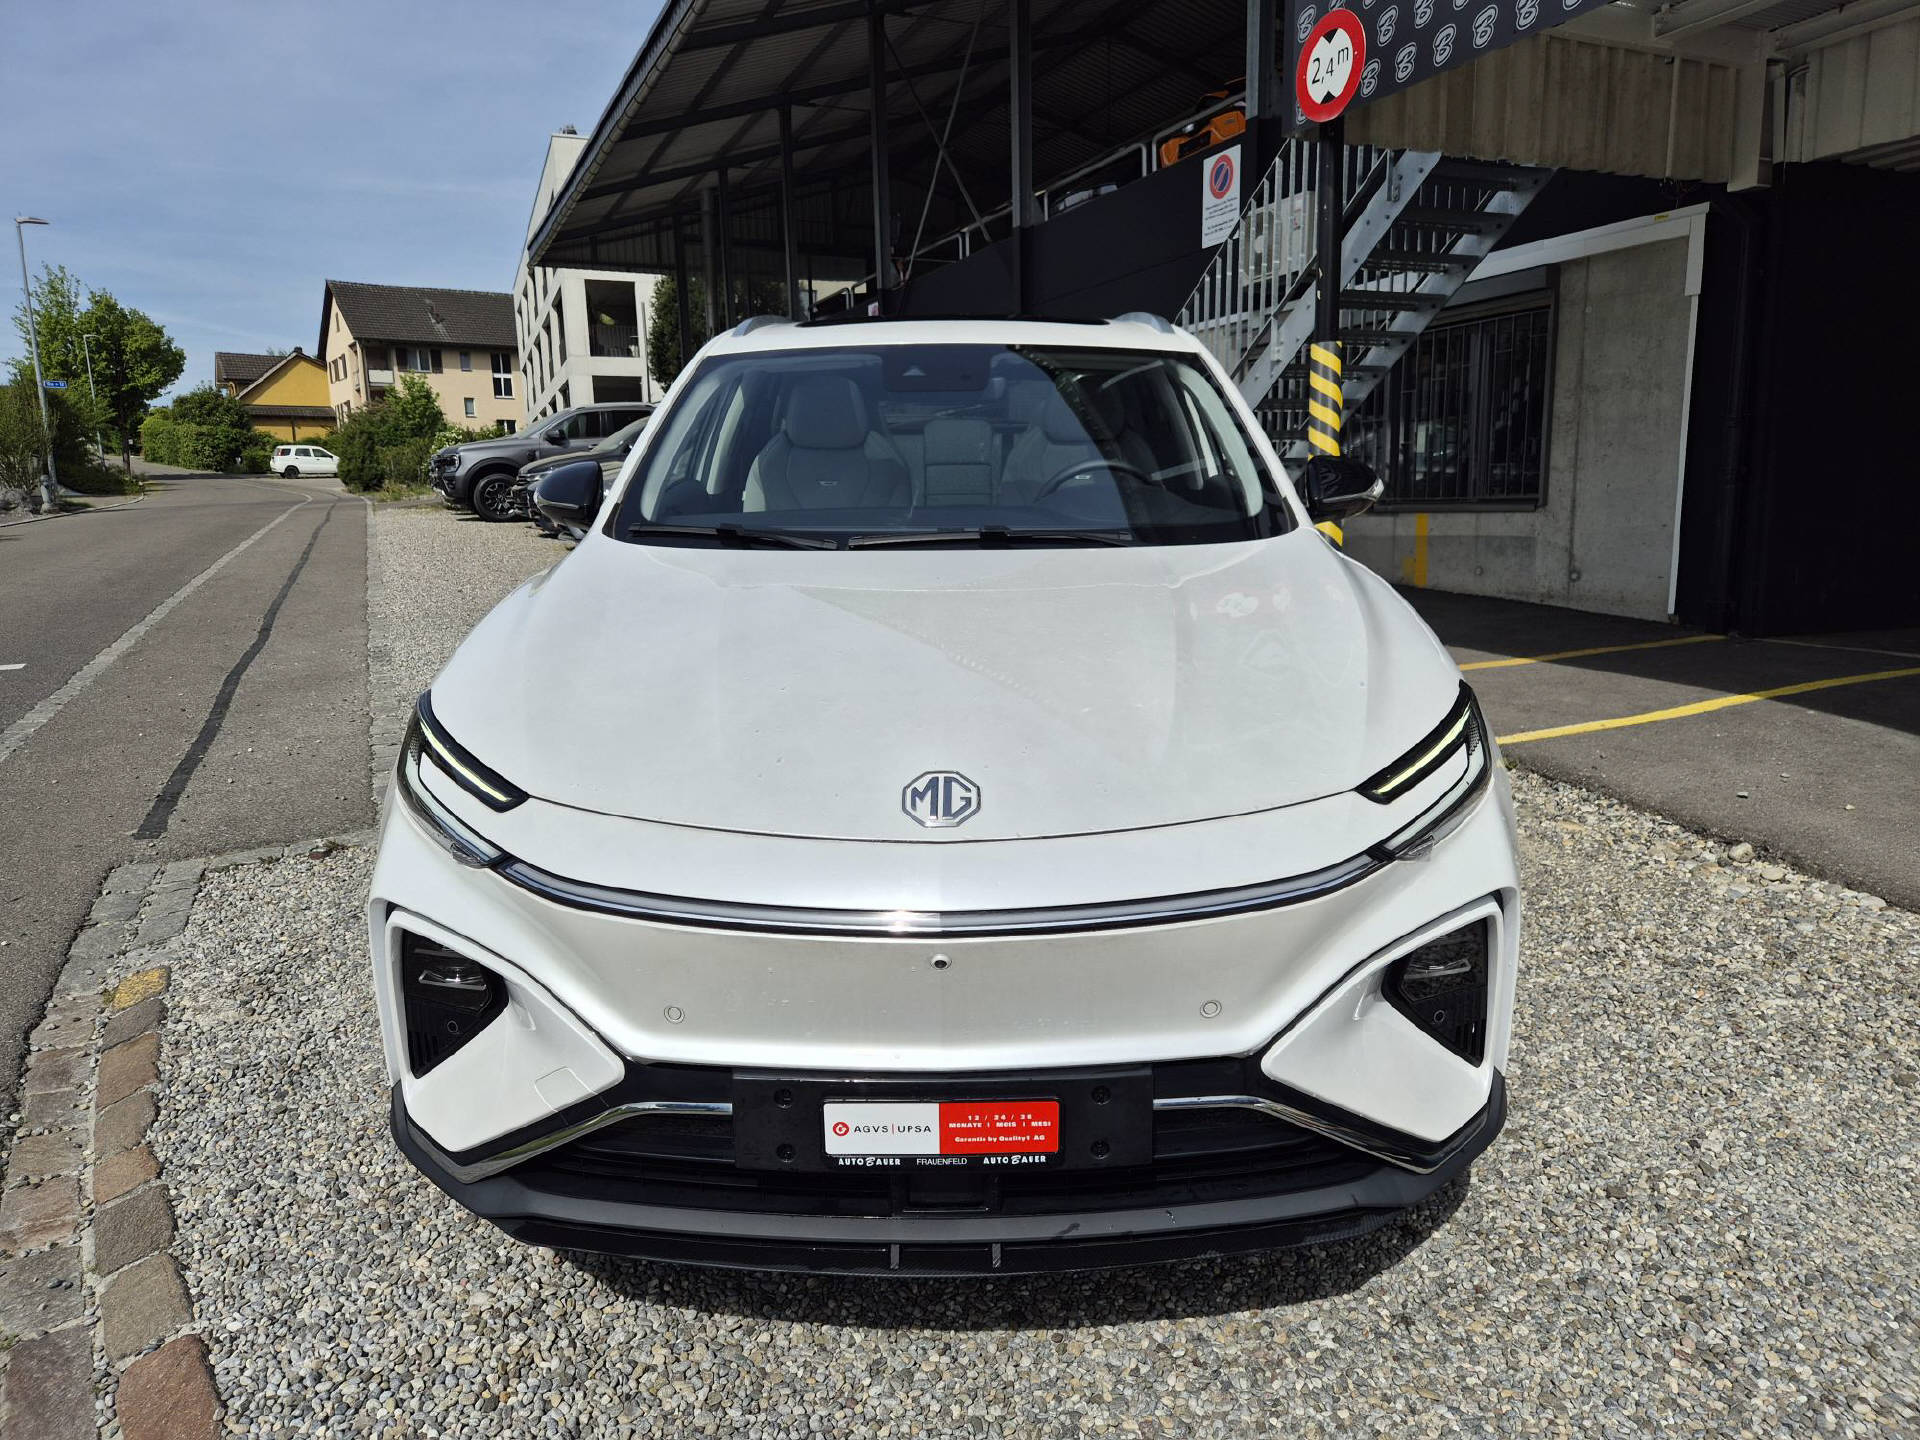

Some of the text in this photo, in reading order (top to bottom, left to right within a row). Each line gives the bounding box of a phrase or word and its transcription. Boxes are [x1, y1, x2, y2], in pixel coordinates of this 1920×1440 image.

[1312, 46, 1350, 85] 2,4 m
[909, 775, 973, 821] MG
[853, 1125, 932, 1134] AGVS UPSA
[987, 1135, 998, 1143] by
[838, 1156, 901, 1167] AUTO BAUER
[916, 1158, 968, 1166] FRAUENFELD
[983, 1155, 1047, 1165] AUTO BAUER
